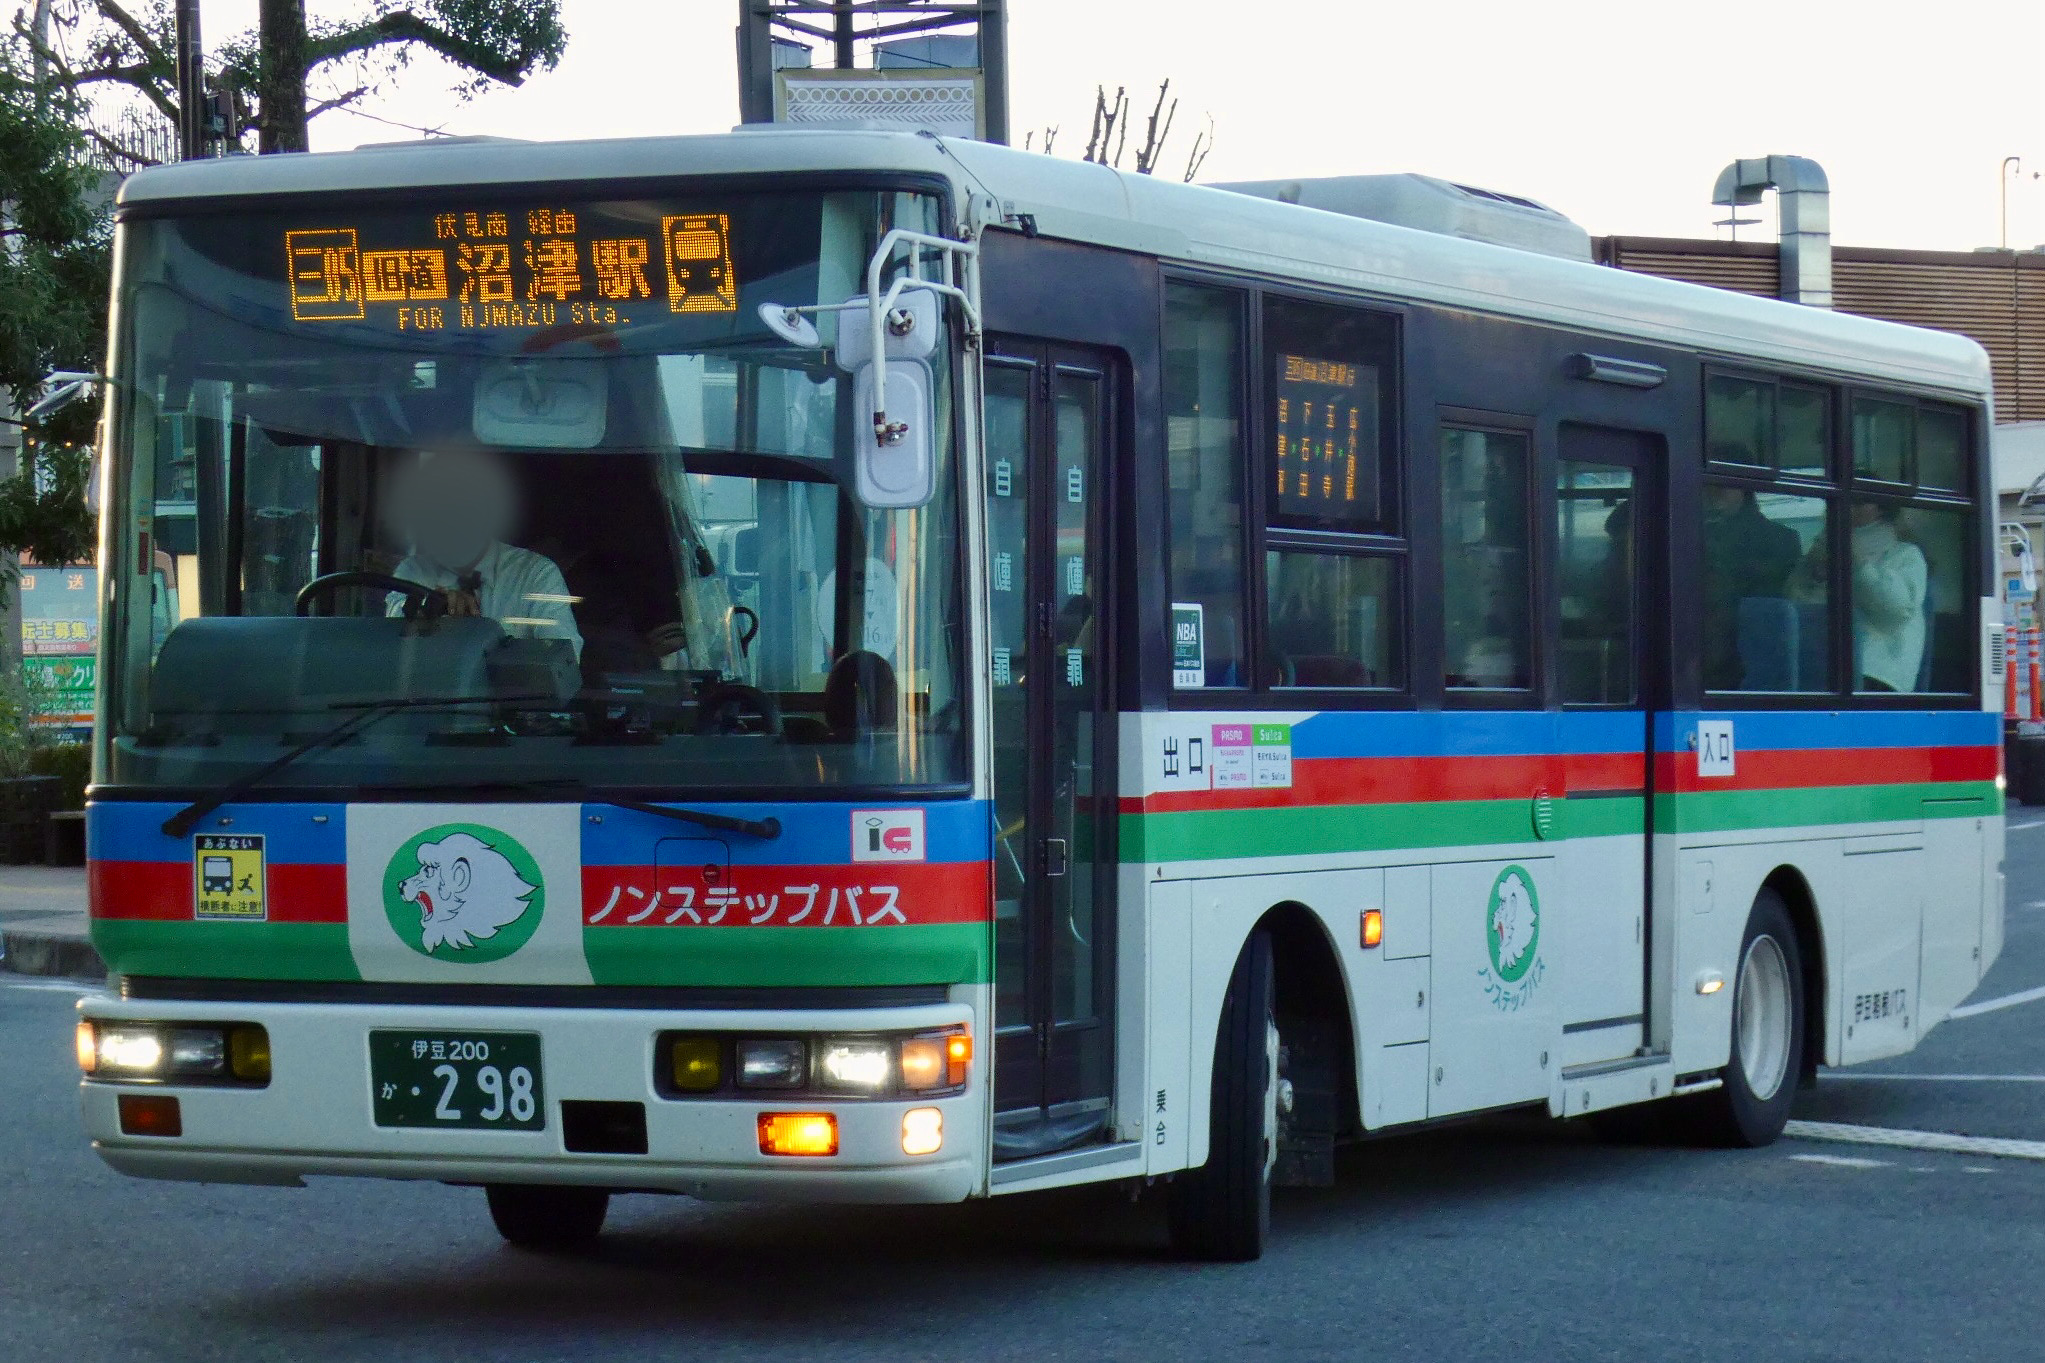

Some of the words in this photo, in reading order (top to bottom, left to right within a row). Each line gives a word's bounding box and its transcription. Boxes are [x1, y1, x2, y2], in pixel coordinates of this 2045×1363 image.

[456, 238, 651, 304] 沼津駅
[399, 306, 444, 331] FOR
[571, 299, 630, 324] Sta.
[1176, 623, 1197, 641] NBA
[1220, 729, 1243, 742] PASMO
[1260, 728, 1283, 742] Suica
[1703, 732, 1729, 763] 入口
[1163, 735, 1203, 778] 出口
[588, 882, 908, 926] ノンステップバス
[380, 1081, 398, 1100] か
